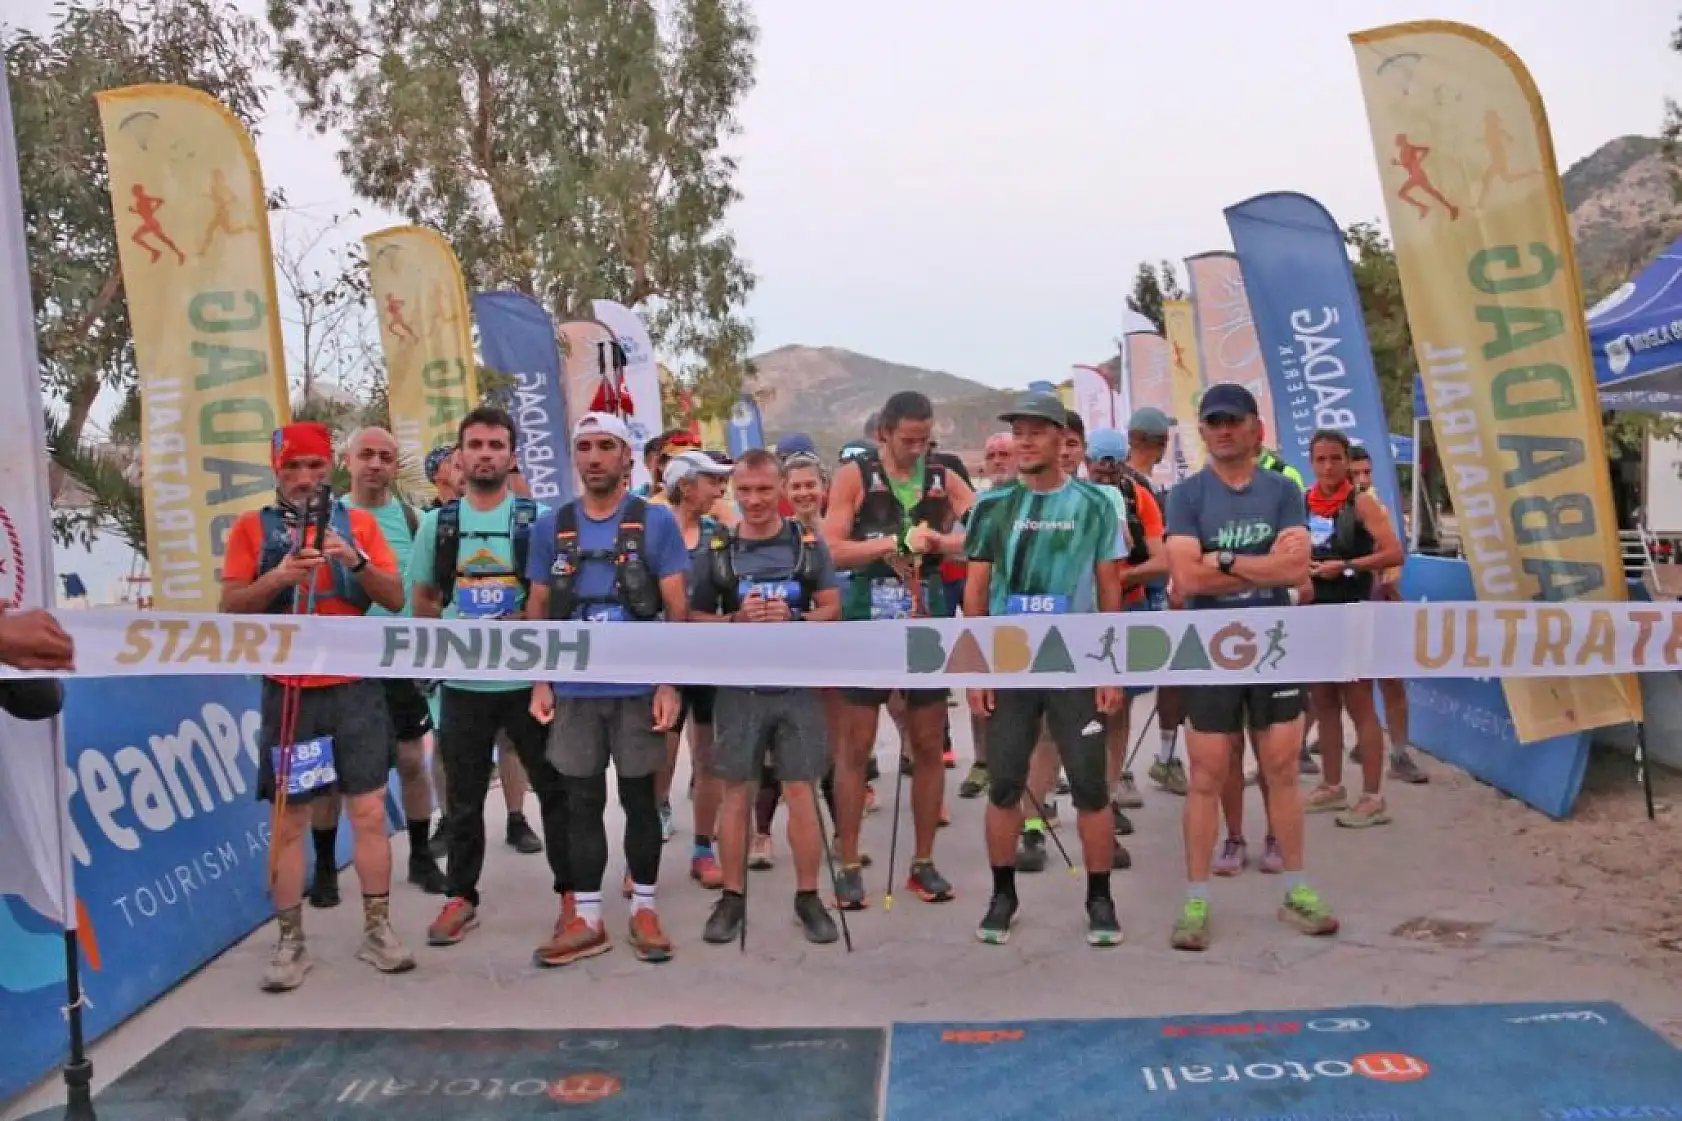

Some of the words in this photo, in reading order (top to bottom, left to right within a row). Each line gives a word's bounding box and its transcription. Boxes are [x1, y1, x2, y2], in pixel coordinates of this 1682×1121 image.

[470, 588, 504, 604] 190
[1020, 596, 1056, 612] 186
[115, 618, 300, 664] START
[379, 625, 591, 671] FINISH
[906, 624, 1076, 675] BABA
[112, 842, 239, 928] TOURISM
[1140, 1054, 1427, 1092] motorall
